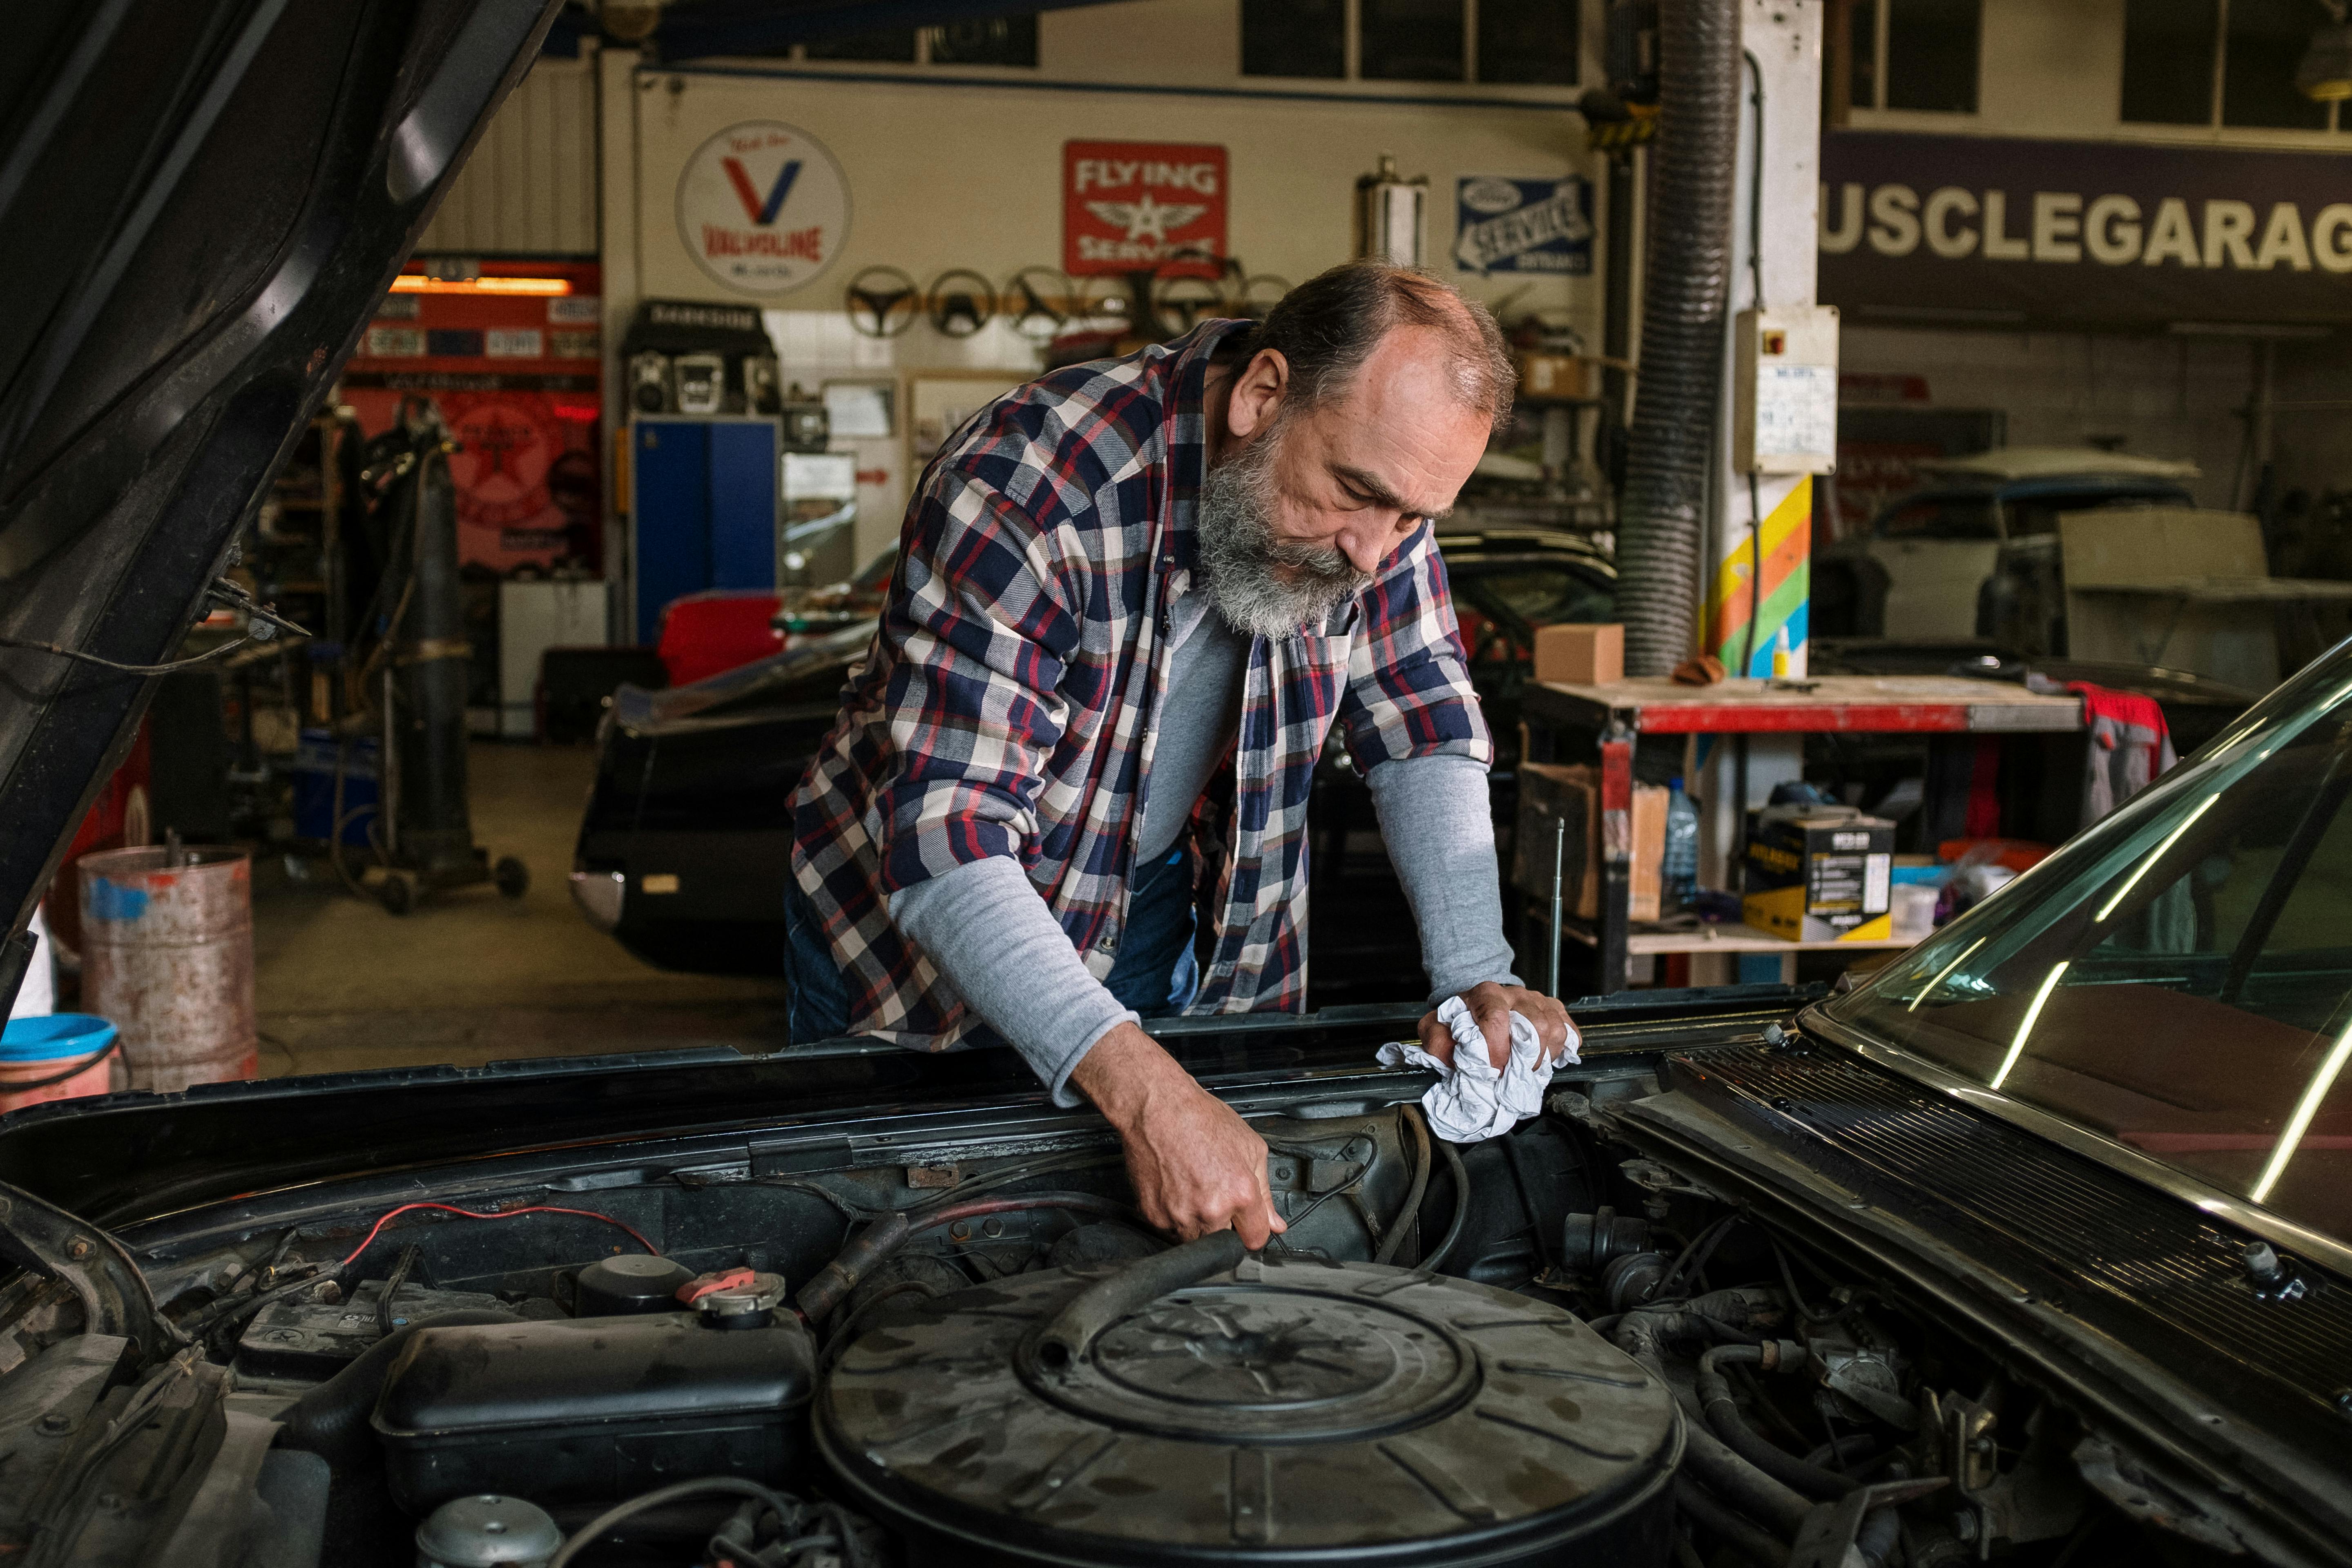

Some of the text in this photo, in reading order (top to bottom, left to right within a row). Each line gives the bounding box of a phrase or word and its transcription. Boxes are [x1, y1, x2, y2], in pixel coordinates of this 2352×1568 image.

[1076, 160, 1217, 195] FLYING
[705, 226, 821, 262] VALVOLINE
[1474, 199, 1577, 260] SERVICE
[1819, 182, 2352, 273] USCLEGARAG
[651, 305, 754, 330] DARKSIDE
